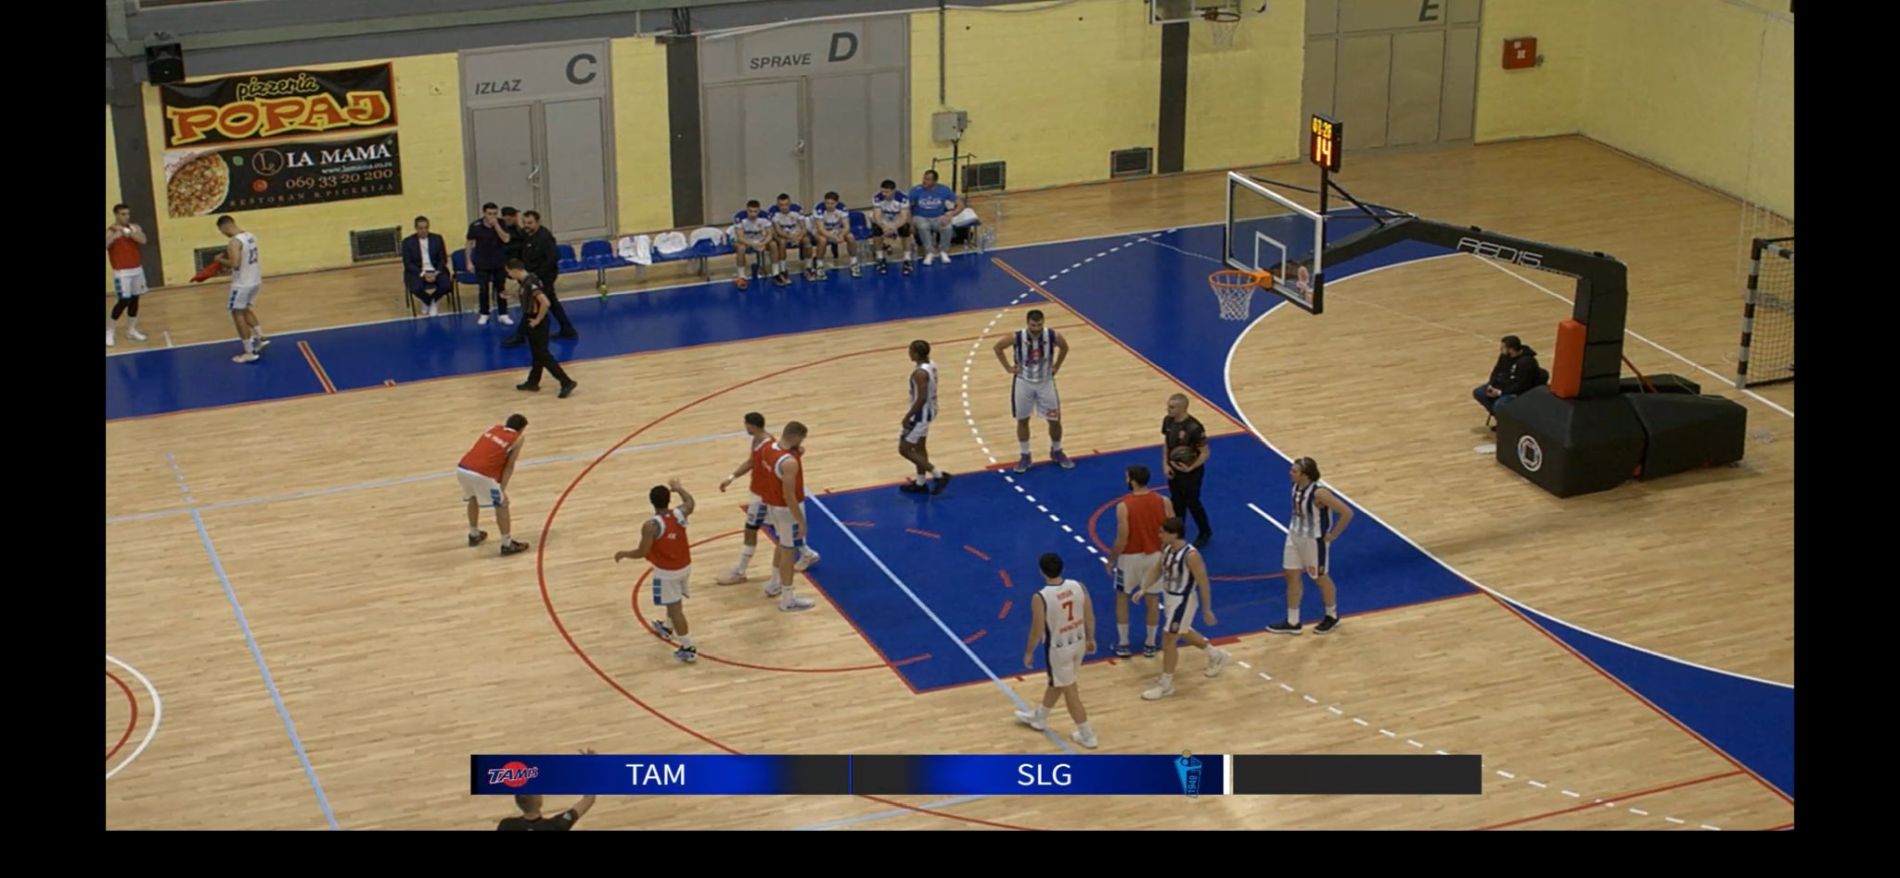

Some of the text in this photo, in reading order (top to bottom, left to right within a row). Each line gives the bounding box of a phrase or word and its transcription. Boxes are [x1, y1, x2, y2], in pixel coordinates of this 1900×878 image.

[750, 31, 859, 70] SPRAVE D
[236, 73, 319, 103] pizzeria
[475, 53, 597, 95] IZLAZ C
[166, 91, 391, 146] POPAJ
[287, 143, 391, 168] LA MAMA
[1316, 135, 1332, 166] 14
[285, 168, 393, 190] 069 33 20 200
[1061, 600, 1074, 622] 7
